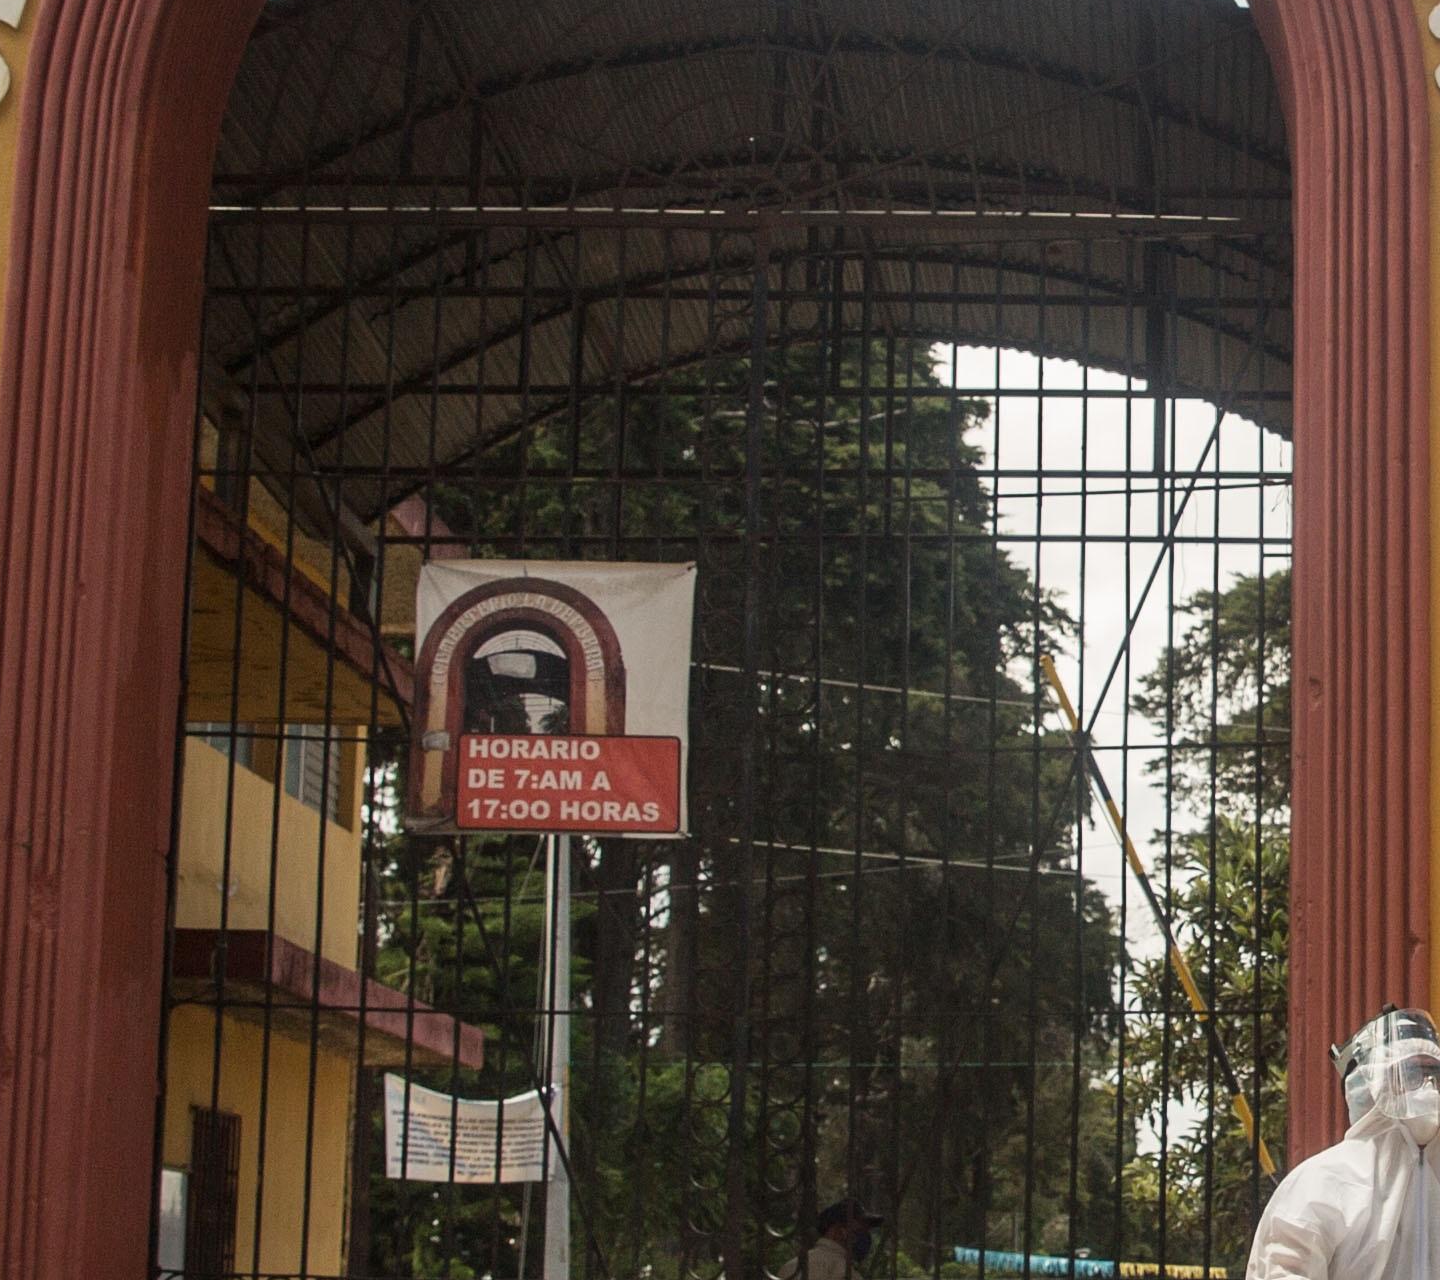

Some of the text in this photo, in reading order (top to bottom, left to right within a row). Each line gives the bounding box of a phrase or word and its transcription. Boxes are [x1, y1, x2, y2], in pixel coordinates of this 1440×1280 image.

[469, 738, 600, 761] HORARIO
[468, 769, 611, 791] DE 7:AM A
[559, 801, 660, 823] HORAS
